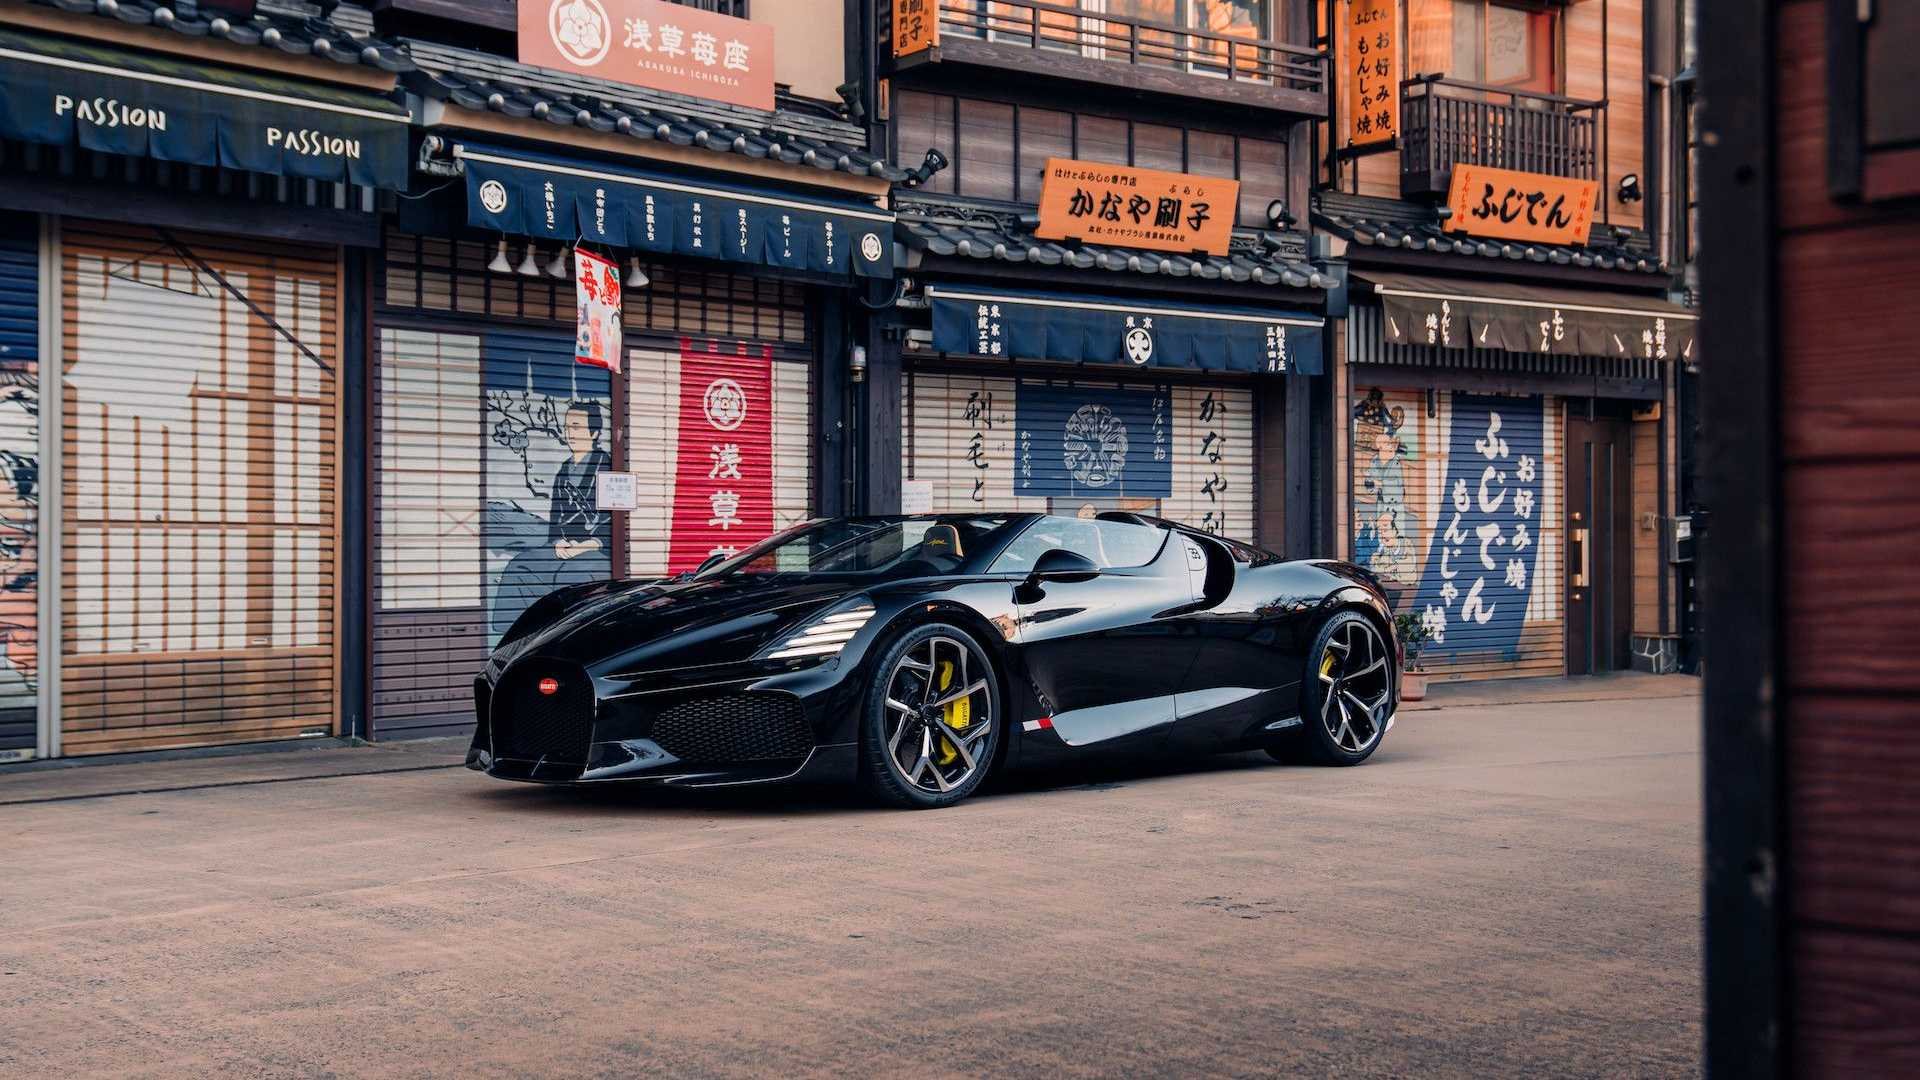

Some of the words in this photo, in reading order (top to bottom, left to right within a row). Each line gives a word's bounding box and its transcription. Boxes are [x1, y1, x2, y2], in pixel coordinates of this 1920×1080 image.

[624, 18, 749, 72] 浅草苺座
[638, 59, 685, 76] ASAKUSA
[690, 69, 739, 86] ICHIGOZA
[1357, 36, 1373, 134] もんじゃ焼
[1376, 32, 1391, 130] お好み焼
[55, 95, 166, 131] PASSION
[267, 128, 360, 159] PASSION
[1068, 186, 1210, 232] かなや刷子
[1472, 183, 1572, 229] ふじでん
[990, 304, 1001, 355] 東京都
[1125, 316, 1153, 329] 東京
[1552, 310, 1564, 341] ふじ
[1461, 411, 1510, 625] ふじでん
[1505, 455, 1536, 590] お好み焼
[1422, 478, 1471, 644] もんじゃ焼
